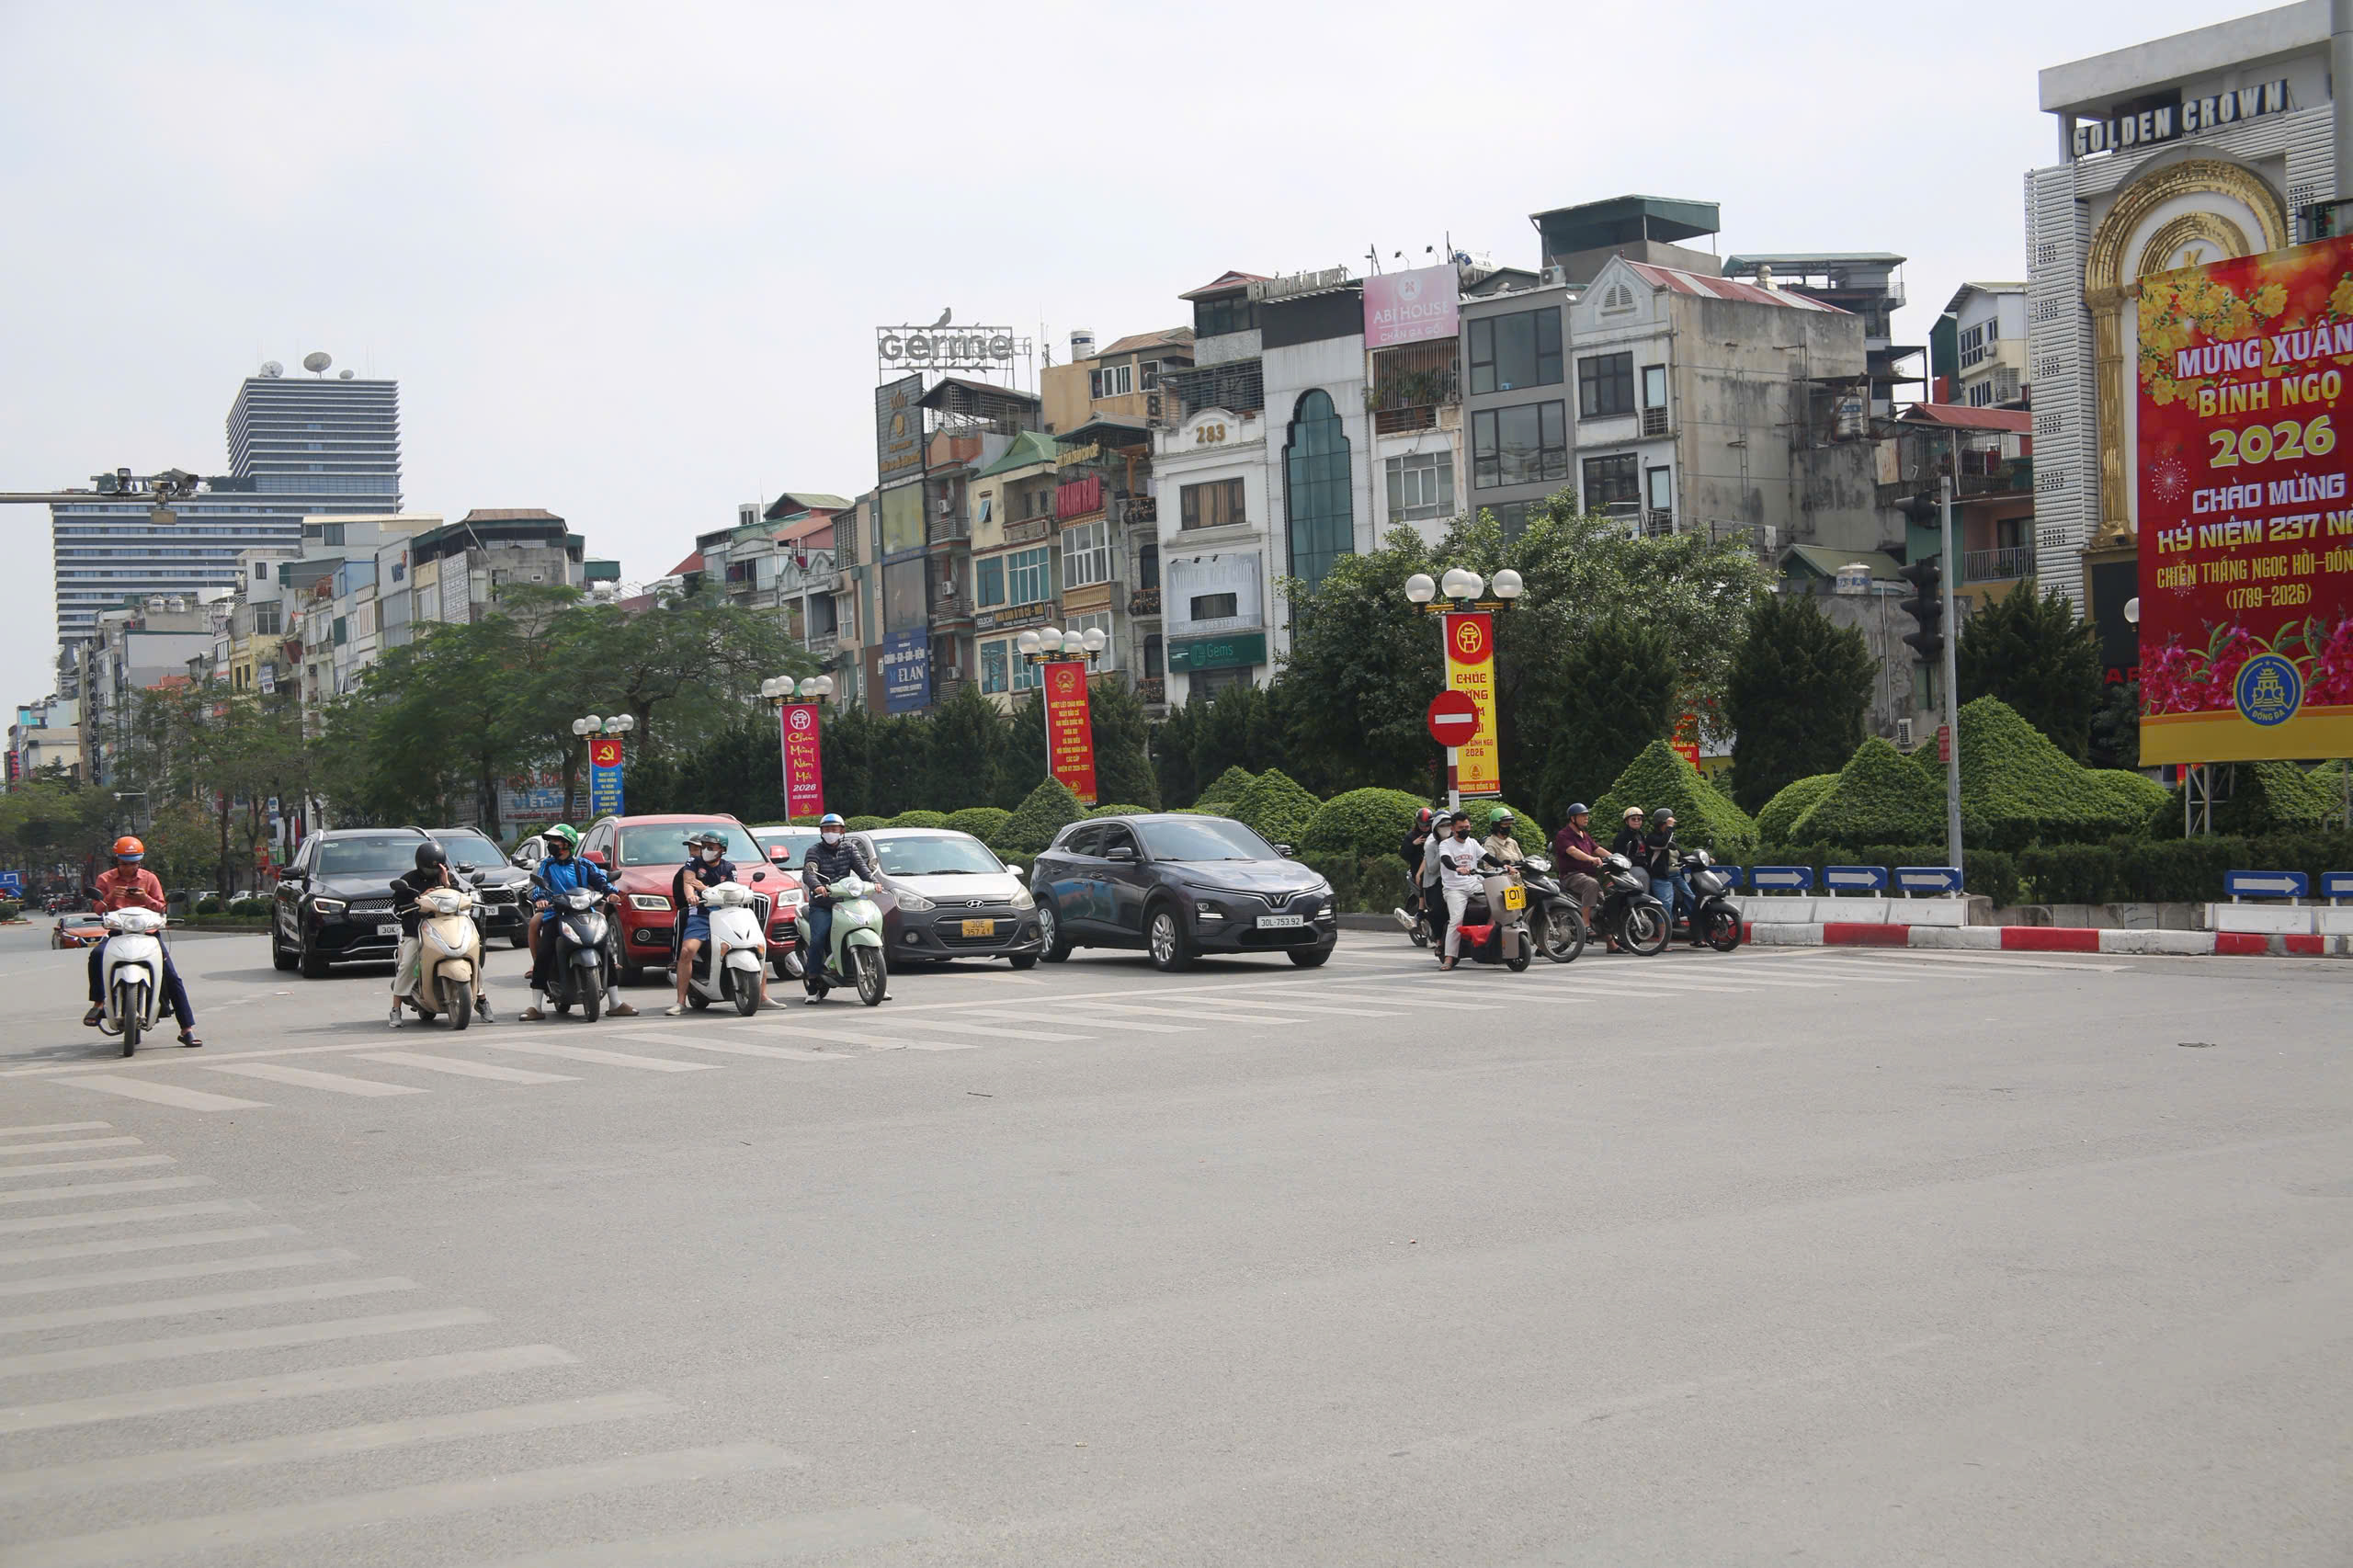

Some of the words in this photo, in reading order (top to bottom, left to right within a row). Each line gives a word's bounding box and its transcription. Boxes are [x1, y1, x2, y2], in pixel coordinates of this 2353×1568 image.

[2073, 108, 2171, 157] GOLDEN
[2182, 79, 2288, 131] CROWN
[1401, 301, 1449, 321] HOUSE
[2176, 336, 2261, 379] MỪNG
[2270, 320, 2353, 365] XUÂN
[2198, 377, 2270, 418] BÍNH
[2282, 369, 2342, 409] NGỌ
[1196, 424, 1226, 443] 283
[2208, 414, 2336, 469] 2026
[2192, 476, 2262, 514] CHÀO
[2268, 469, 2346, 506] MỪNG
[2157, 518, 2193, 553] KỶ
[2200, 515, 2263, 551] NIỆM
[2268, 512, 2321, 542] 237
[2157, 556, 2197, 589] CHIẾN
[2201, 555, 2249, 584] THẮNG
[2252, 555, 2288, 582] NGỌC
[1206, 643, 1233, 657] Gems
[1456, 672, 1486, 684] CHÚC
[1463, 688, 1488, 700] ỪNG
[1465, 747, 1484, 757] 2026
[792, 783, 817, 792] 2026
[1261, 917, 1300, 926] 30L-753.92
